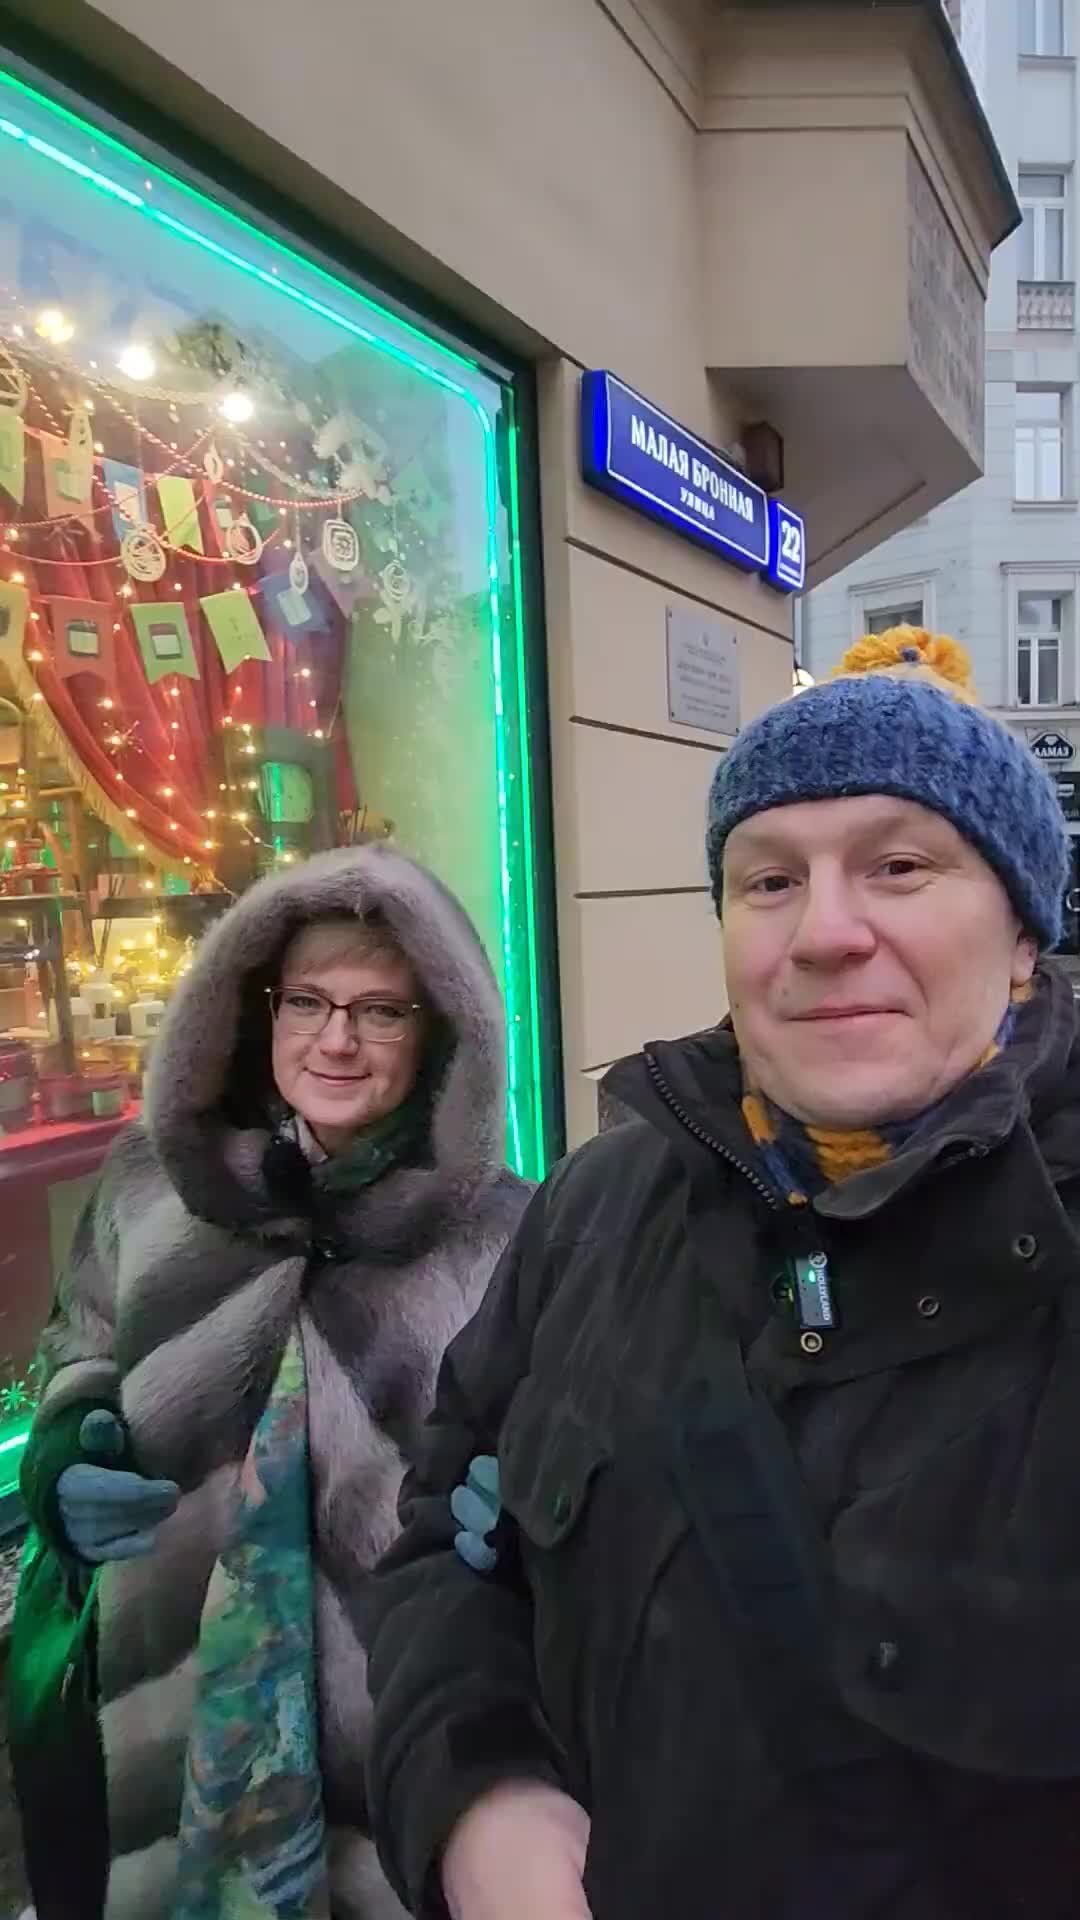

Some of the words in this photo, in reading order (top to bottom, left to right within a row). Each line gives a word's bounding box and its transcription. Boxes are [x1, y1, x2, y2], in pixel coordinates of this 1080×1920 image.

[631, 414, 689, 481] МАЛАЯ
[692, 457, 754, 523] БРОННАЯ
[680, 486, 715, 521] УЛИЦА
[780, 519, 801, 565] 22
[815, 1268, 831, 1321] HOLLYLAND
